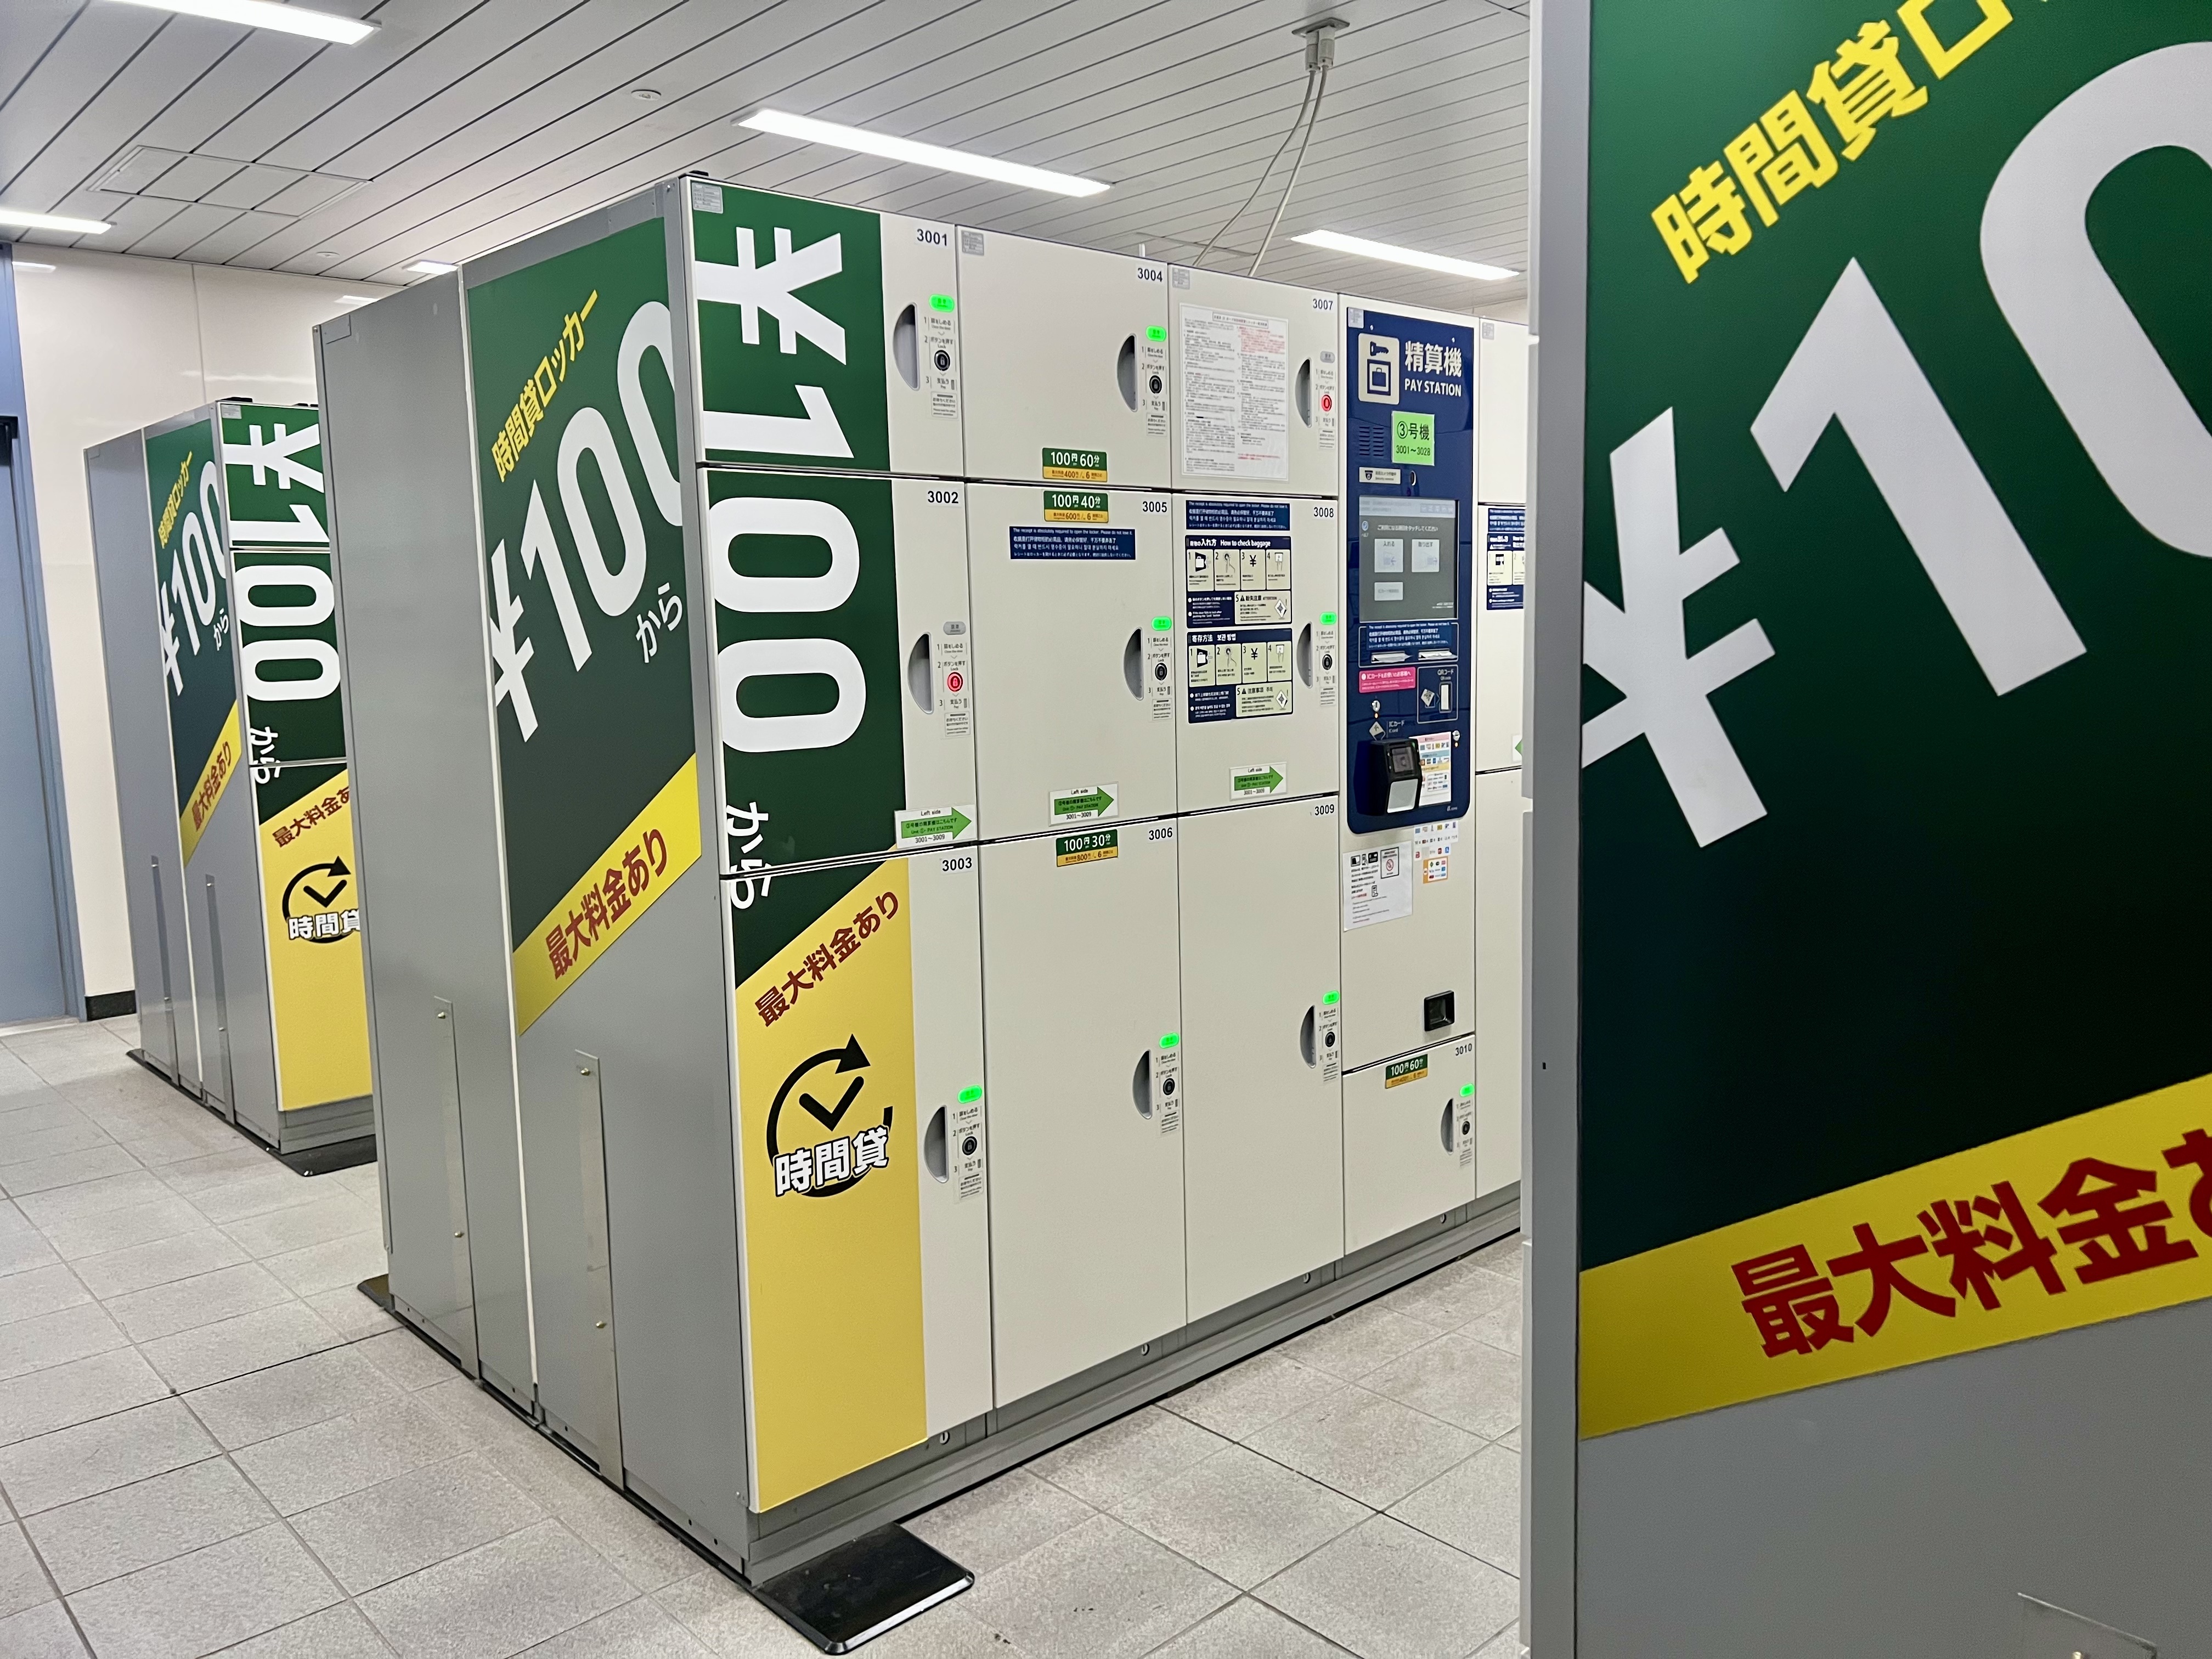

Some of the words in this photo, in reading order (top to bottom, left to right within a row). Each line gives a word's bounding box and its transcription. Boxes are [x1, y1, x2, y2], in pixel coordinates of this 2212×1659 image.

[1651, 0, 2015, 283] 時間貸ロ
[916, 229, 948, 246] 3001
[1137, 267, 1163, 283] 3004
[1313, 298, 1333, 311] 3007
[1405, 340, 1462, 377] 精算機
[491, 289, 598, 483] 時間貸ロッカー
[1404, 377, 1421, 392] PAY
[1424, 381, 1462, 397] STATION
[1397, 421, 1430, 441] ③号機
[695, 226, 868, 753] ¥100
[927, 490, 959, 504] 3002
[1142, 501, 1167, 512] 3005
[1313, 507, 1334, 517] 3008
[223, 422, 341, 701] ¥100
[212, 607, 229, 651] から
[636, 582, 682, 663] から
[1217, 647, 1220, 655] 2
[190, 741, 232, 831] 最大料金あり
[1314, 804, 1335, 816] 3009
[1149, 827, 1173, 840] 3006
[942, 857, 972, 871] 3003
[545, 828, 667, 980] 最大料金あり
[754, 891, 899, 1027] 最大料金あり
[1455, 1043, 1472, 1056] 3010
[775, 1126, 889, 1196] 時間貸
